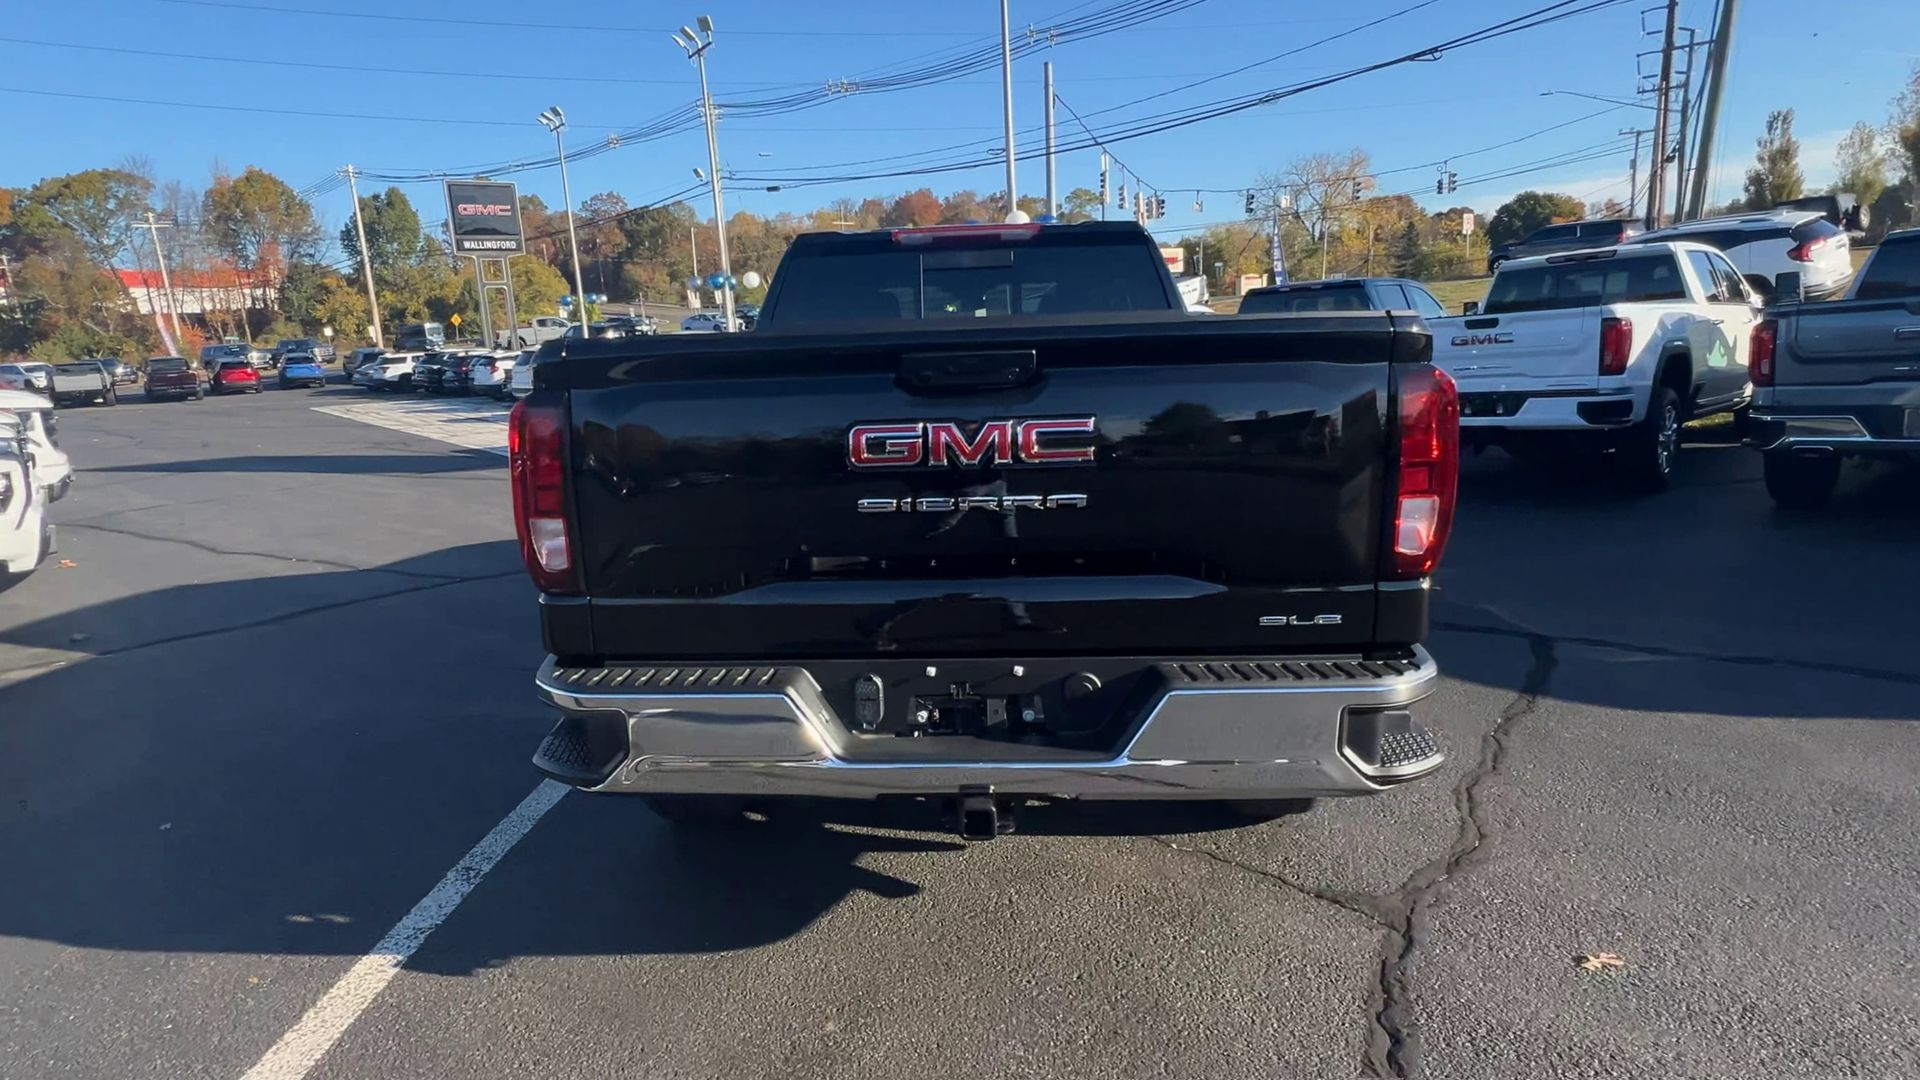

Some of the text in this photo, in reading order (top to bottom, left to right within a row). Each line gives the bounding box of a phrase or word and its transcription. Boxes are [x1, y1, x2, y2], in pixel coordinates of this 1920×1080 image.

[458, 203, 512, 216] GMC
[463, 240, 517, 249] WALLINGFORD
[1451, 332, 1515, 346] GMC
[848, 416, 1096, 467] GMC
[857, 494, 1088, 512] SIERRA
[1259, 614, 1342, 626] SLE
